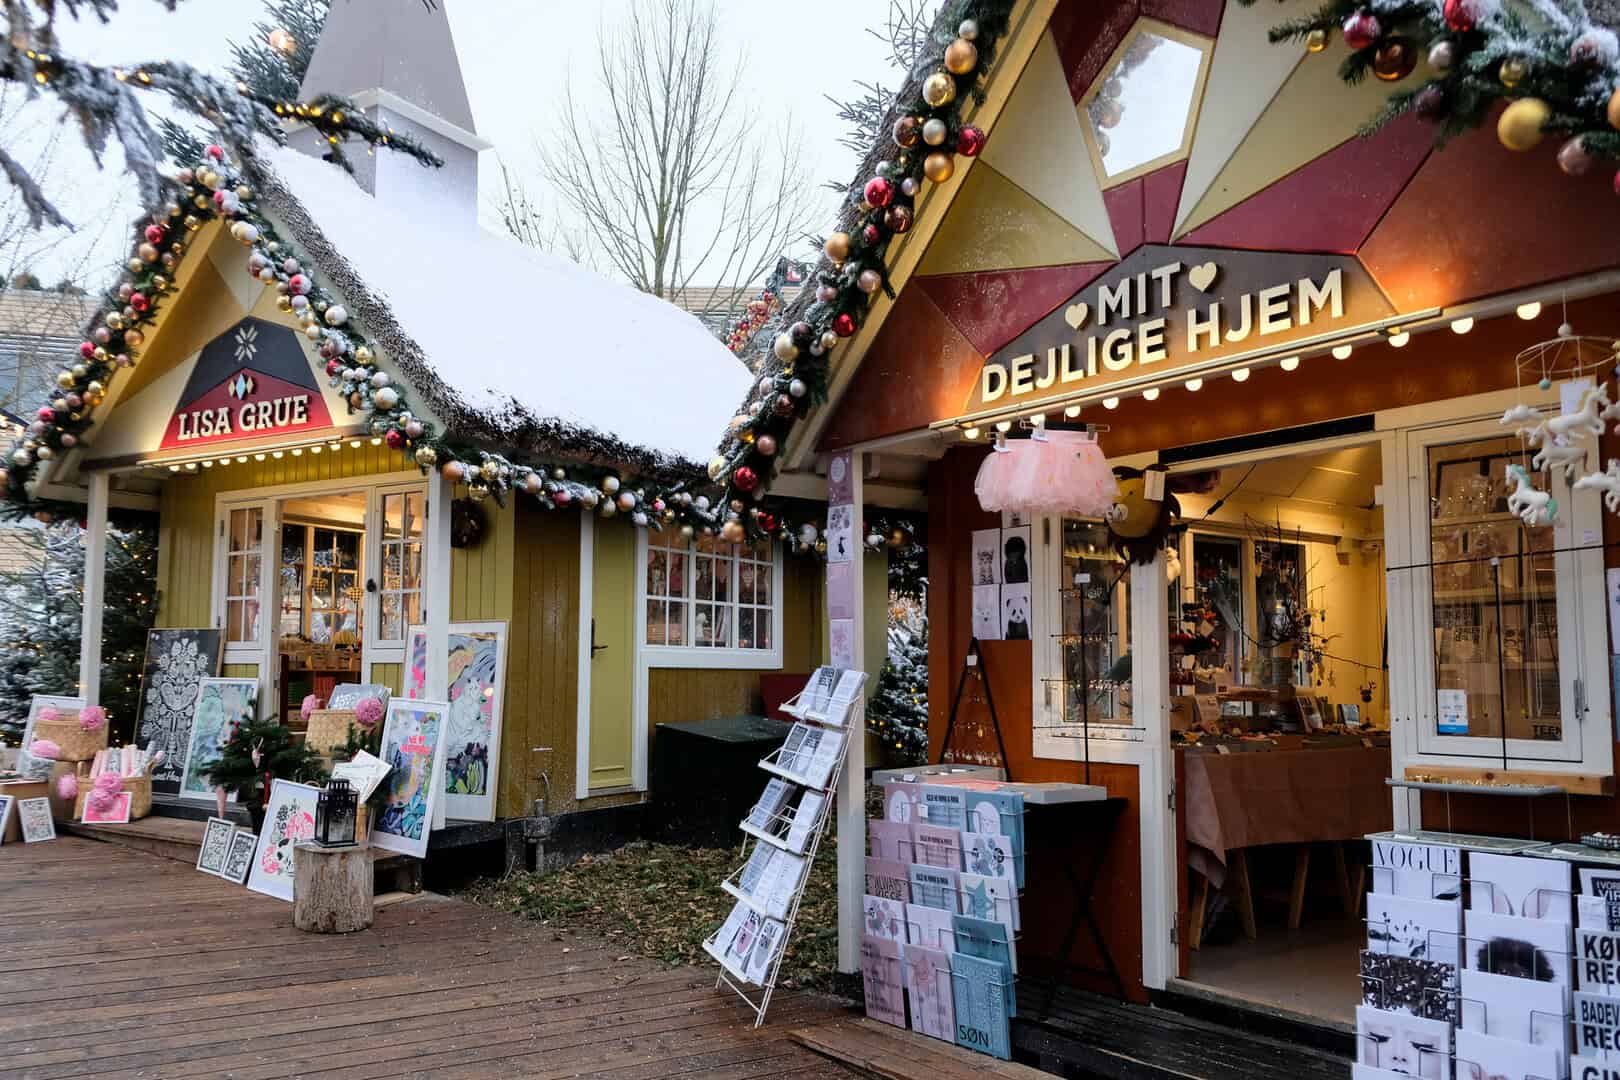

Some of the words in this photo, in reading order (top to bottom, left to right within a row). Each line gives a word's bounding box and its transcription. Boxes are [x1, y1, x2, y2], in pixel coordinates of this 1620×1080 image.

[1098, 261, 1183, 325] MIT
[982, 317, 1168, 402] DEJLIGE
[1186, 268, 1344, 352] HJEM
[177, 406, 233, 441] LISA
[239, 394, 309, 432] GRUE
[1376, 843, 1458, 874] VOGUE
[959, 1025, 989, 1048] SØN
